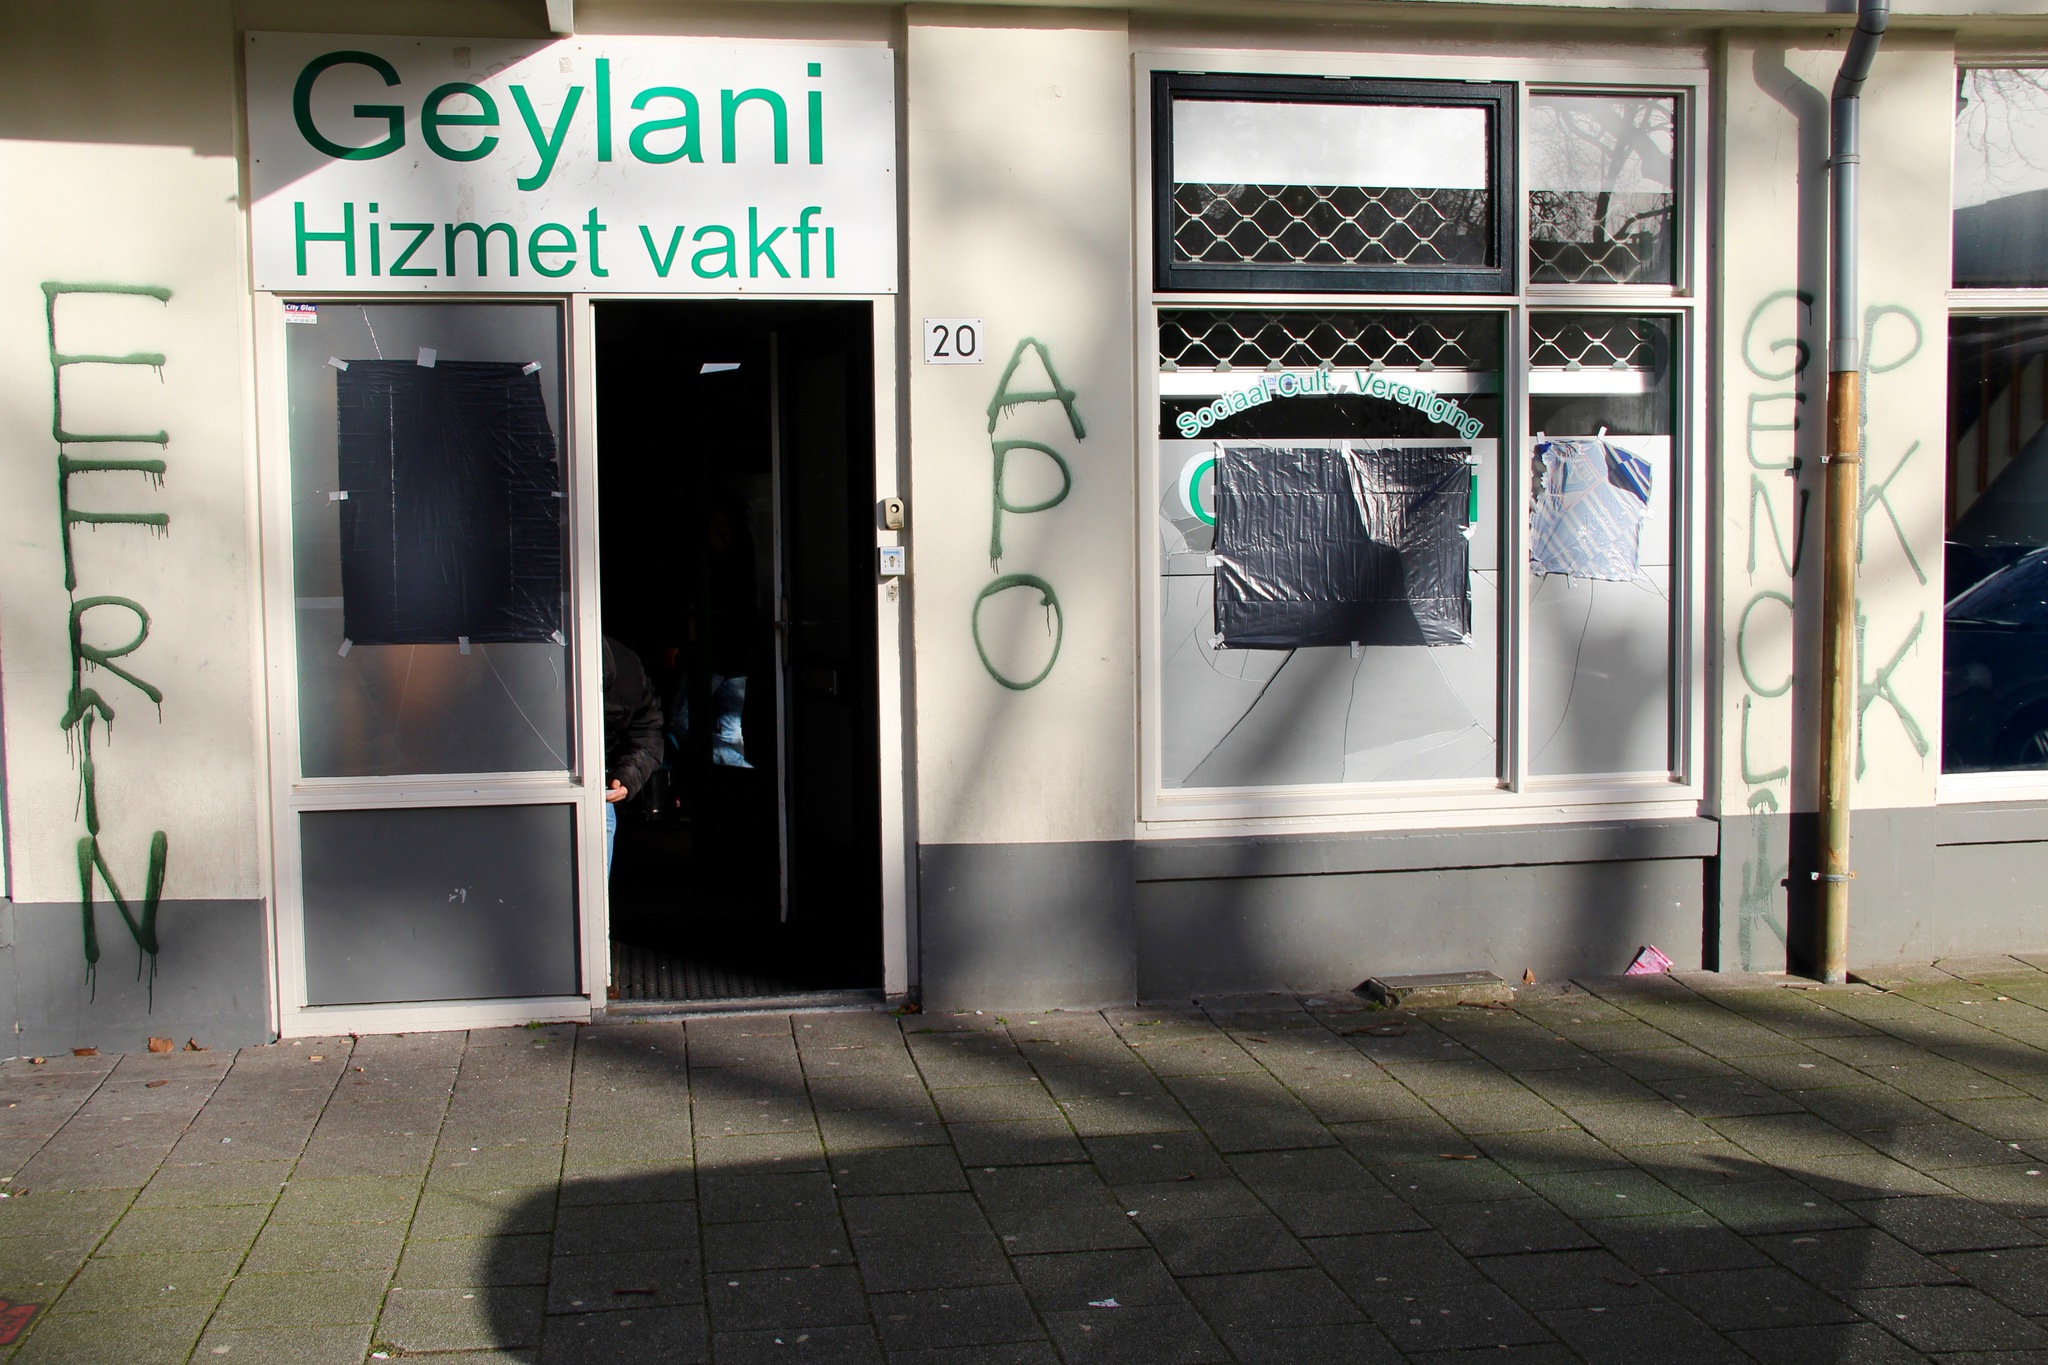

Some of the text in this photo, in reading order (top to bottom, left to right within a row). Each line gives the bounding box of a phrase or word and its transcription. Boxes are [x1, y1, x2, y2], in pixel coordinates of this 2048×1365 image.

[292, 50, 824, 191] Geylani
[295, 202, 609, 279] Hizmet
[932, 324, 976, 357] 20
[1177, 368, 1485, 442] Sociaal Cult. Vereniging
[972, 336, 1087, 691] APO
